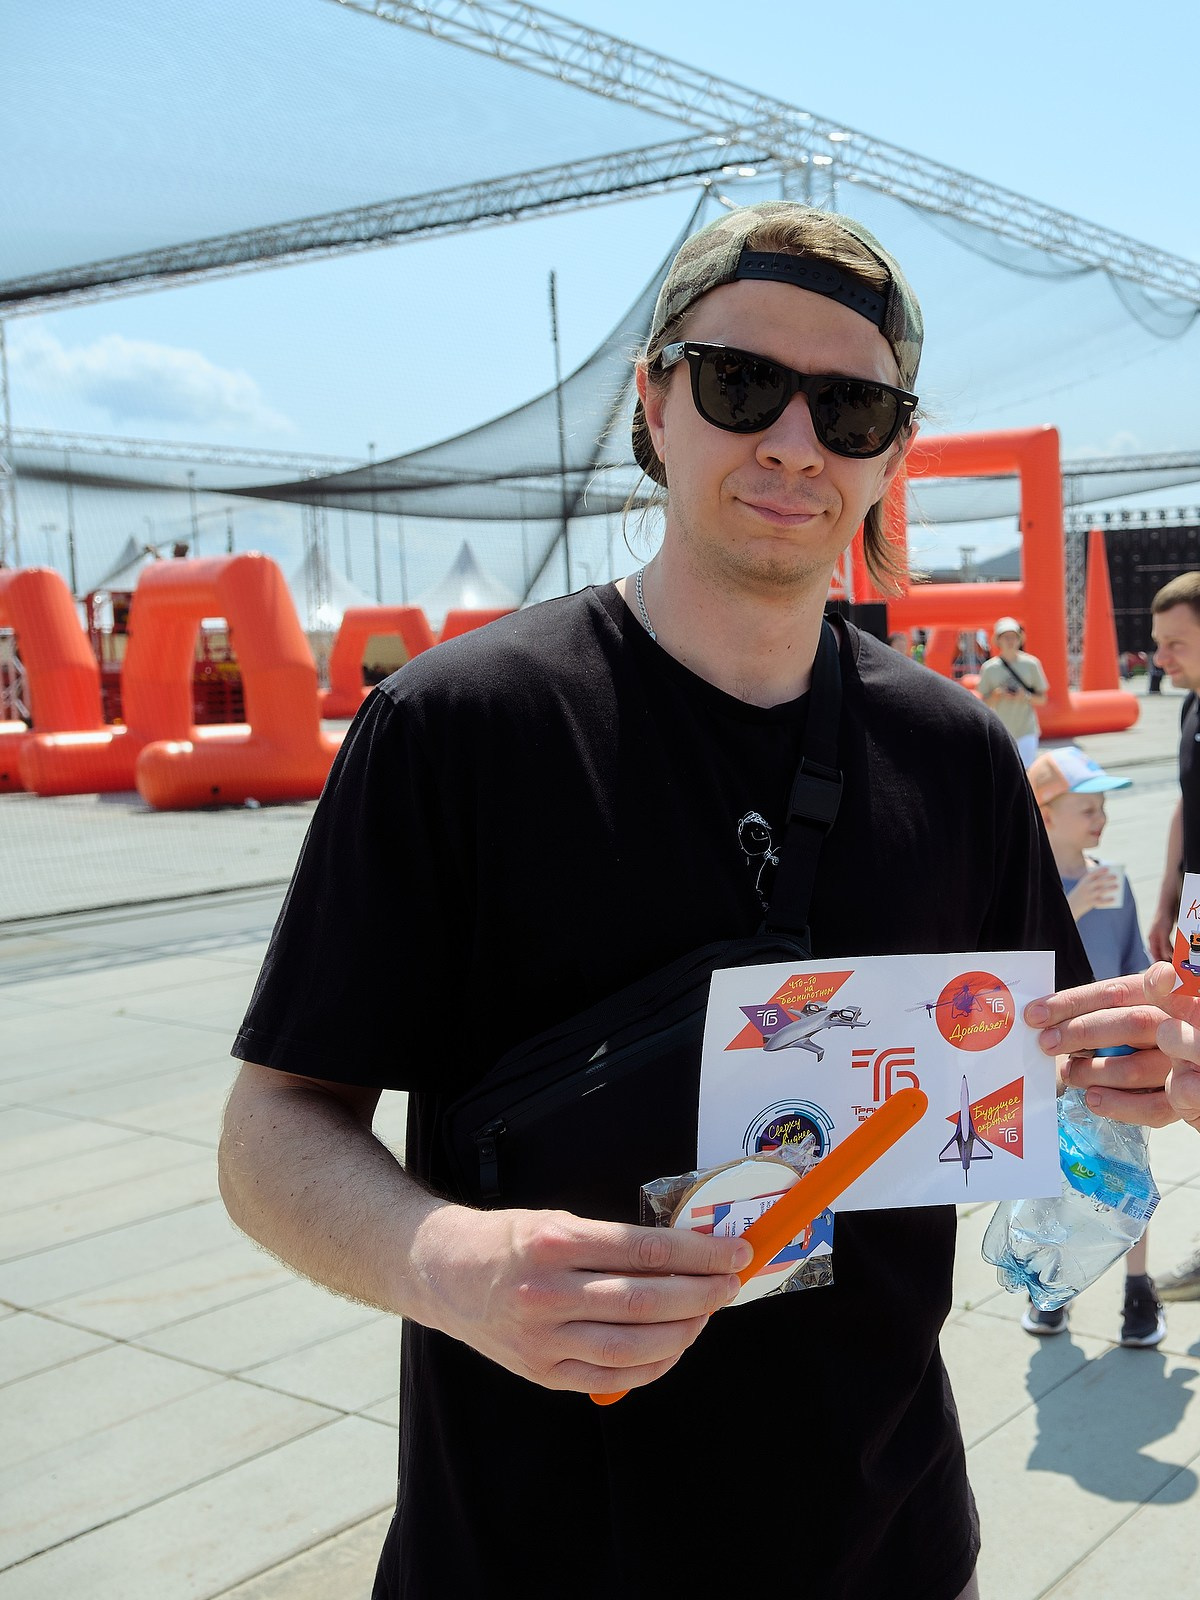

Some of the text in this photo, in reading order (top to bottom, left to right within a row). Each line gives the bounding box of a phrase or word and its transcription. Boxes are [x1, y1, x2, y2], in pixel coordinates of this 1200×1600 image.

[804, 984, 814, 993] на
[948, 1011, 1010, 1042] Доставляет!
[972, 1096, 1021, 1122] Будущее
[768, 1118, 801, 1140] Сверху
